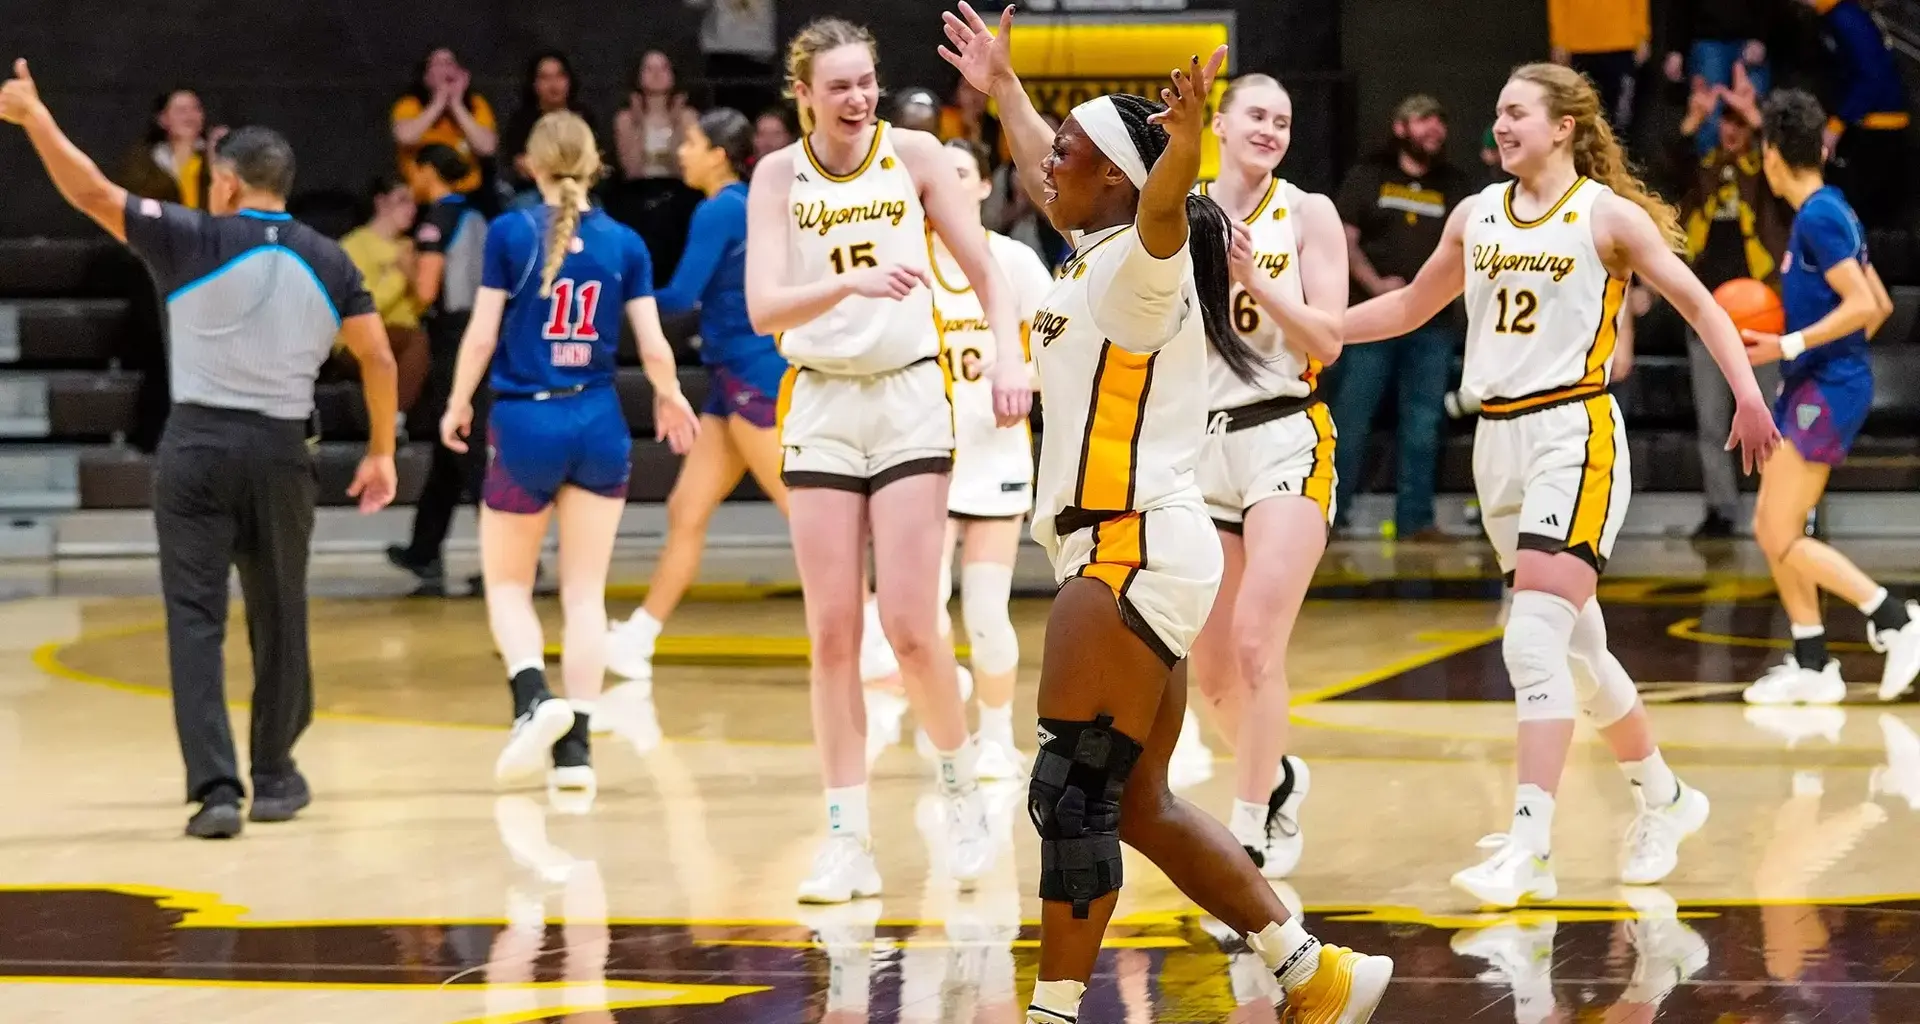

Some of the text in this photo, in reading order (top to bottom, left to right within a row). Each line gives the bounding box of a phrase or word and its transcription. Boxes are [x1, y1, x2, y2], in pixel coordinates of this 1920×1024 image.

[793, 200, 906, 236] Wyoming
[830, 241, 878, 274] 15
[1472, 243, 1576, 282] Wyoming
[541, 277, 602, 341] 11
[1494, 287, 1539, 335] 12
